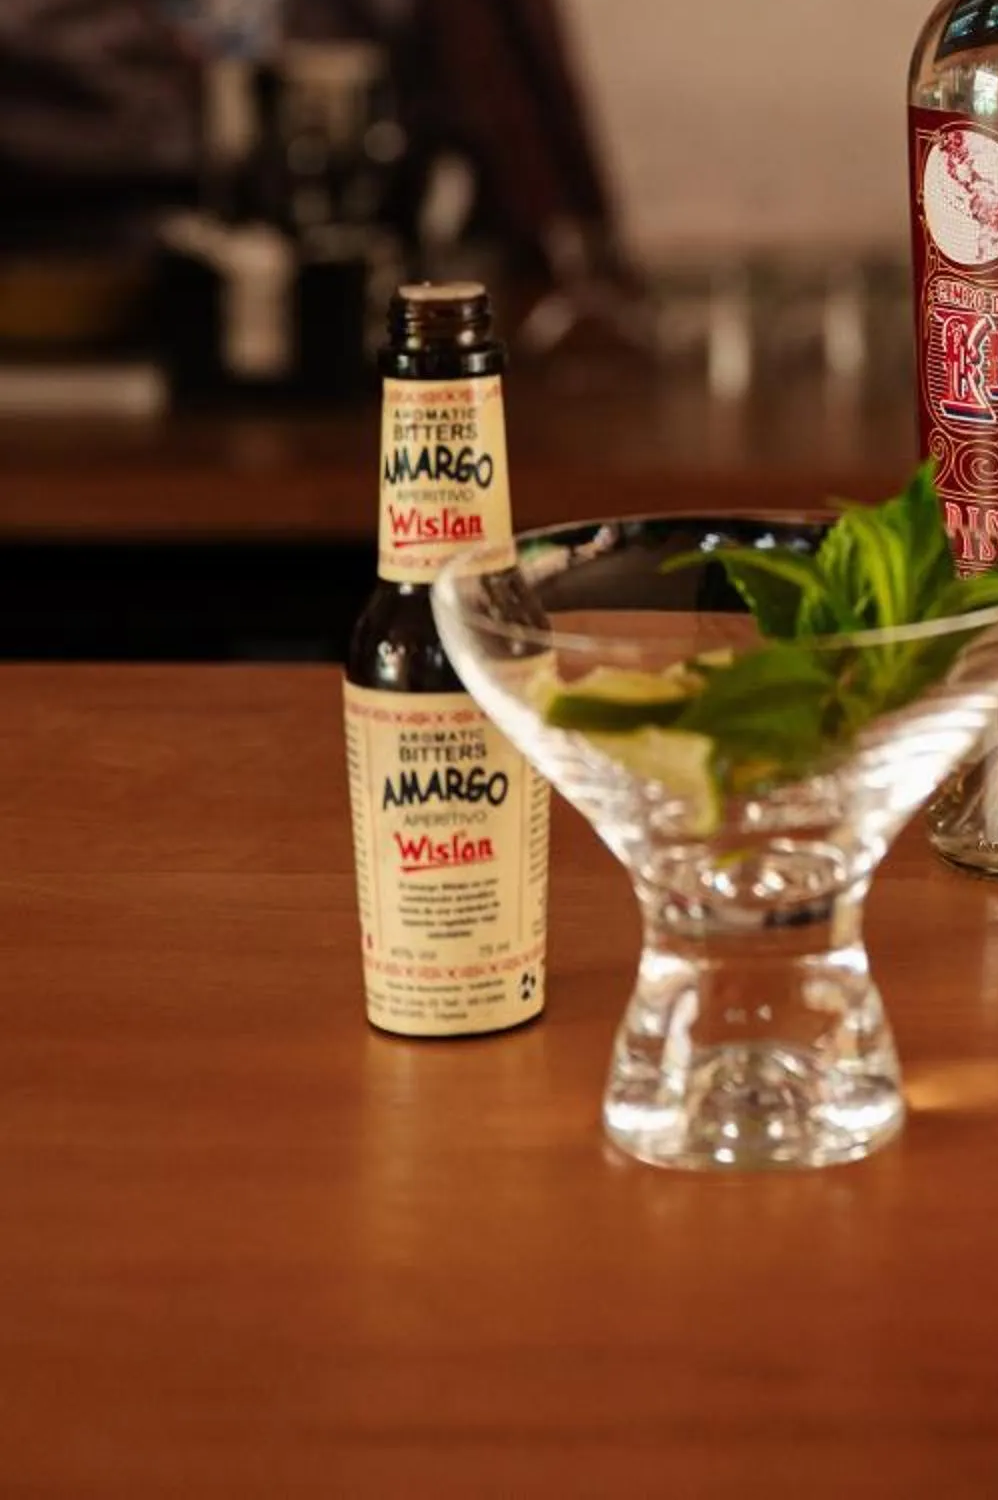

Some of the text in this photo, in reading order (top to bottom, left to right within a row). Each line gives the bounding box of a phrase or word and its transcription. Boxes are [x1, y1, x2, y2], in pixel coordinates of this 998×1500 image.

[394, 407, 477, 421] AROMATIC
[393, 423, 478, 442] BITTERS
[384, 444, 493, 490] AMARGO
[400, 728, 485, 743] AROMATIC
[400, 743, 487, 763] BITTERS
[382, 765, 508, 812] AMARGO
